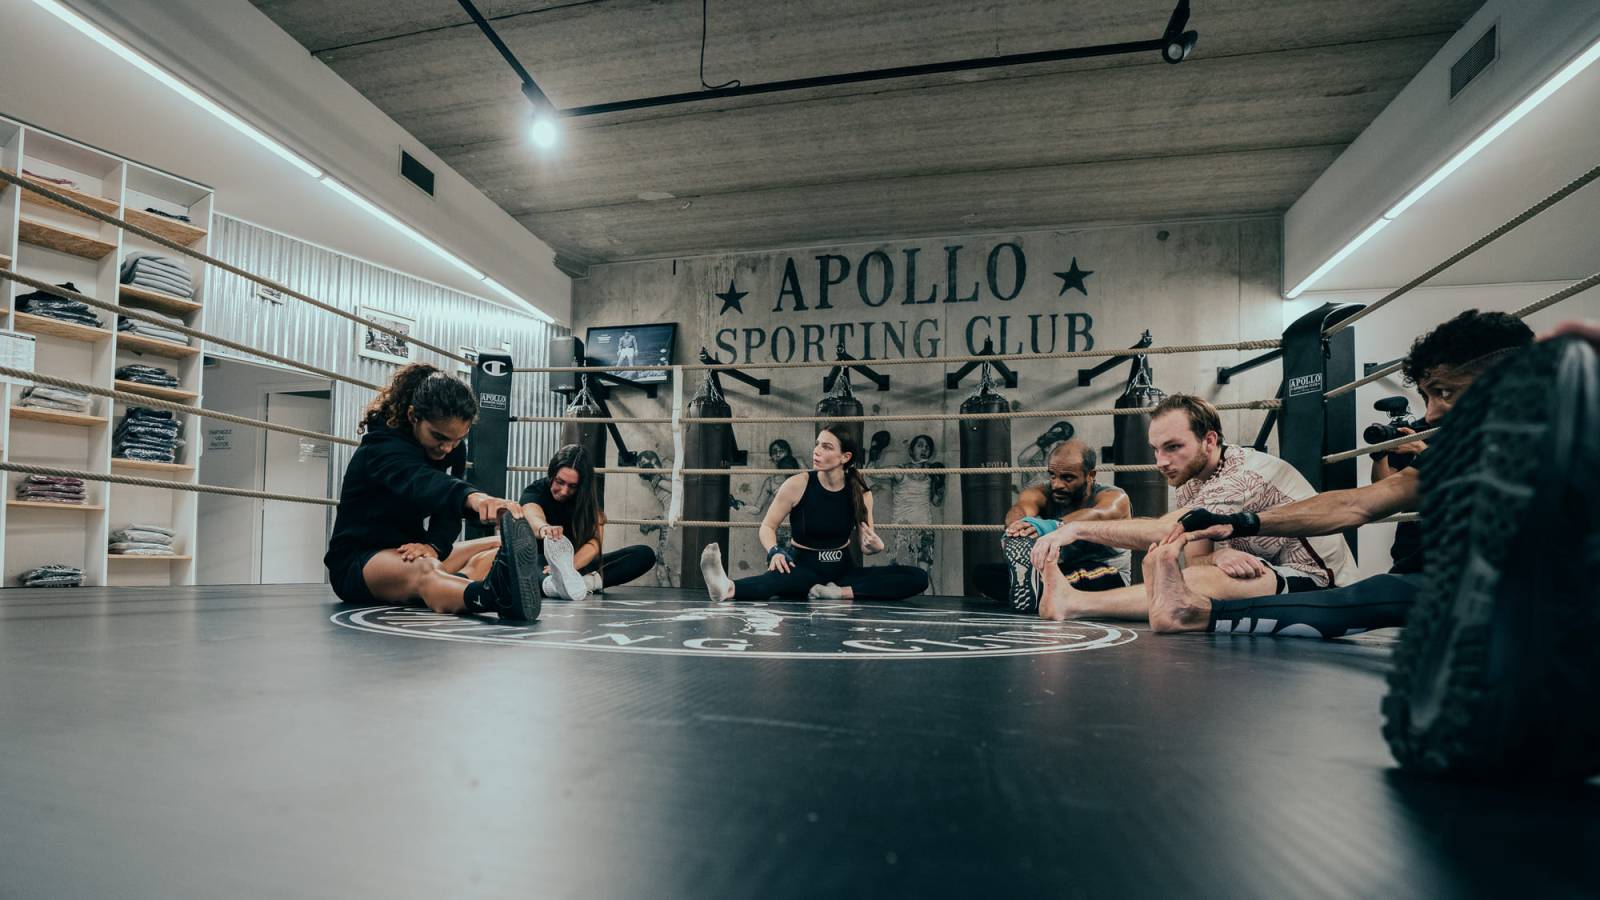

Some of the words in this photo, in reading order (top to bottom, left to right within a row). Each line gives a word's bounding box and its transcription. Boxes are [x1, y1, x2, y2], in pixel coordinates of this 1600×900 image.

[772, 242, 1027, 312] APOLLO
[715, 319, 941, 364] SPORTING
[966, 312, 1095, 355] CLUB
[1290, 374, 1321, 386] APOLLO
